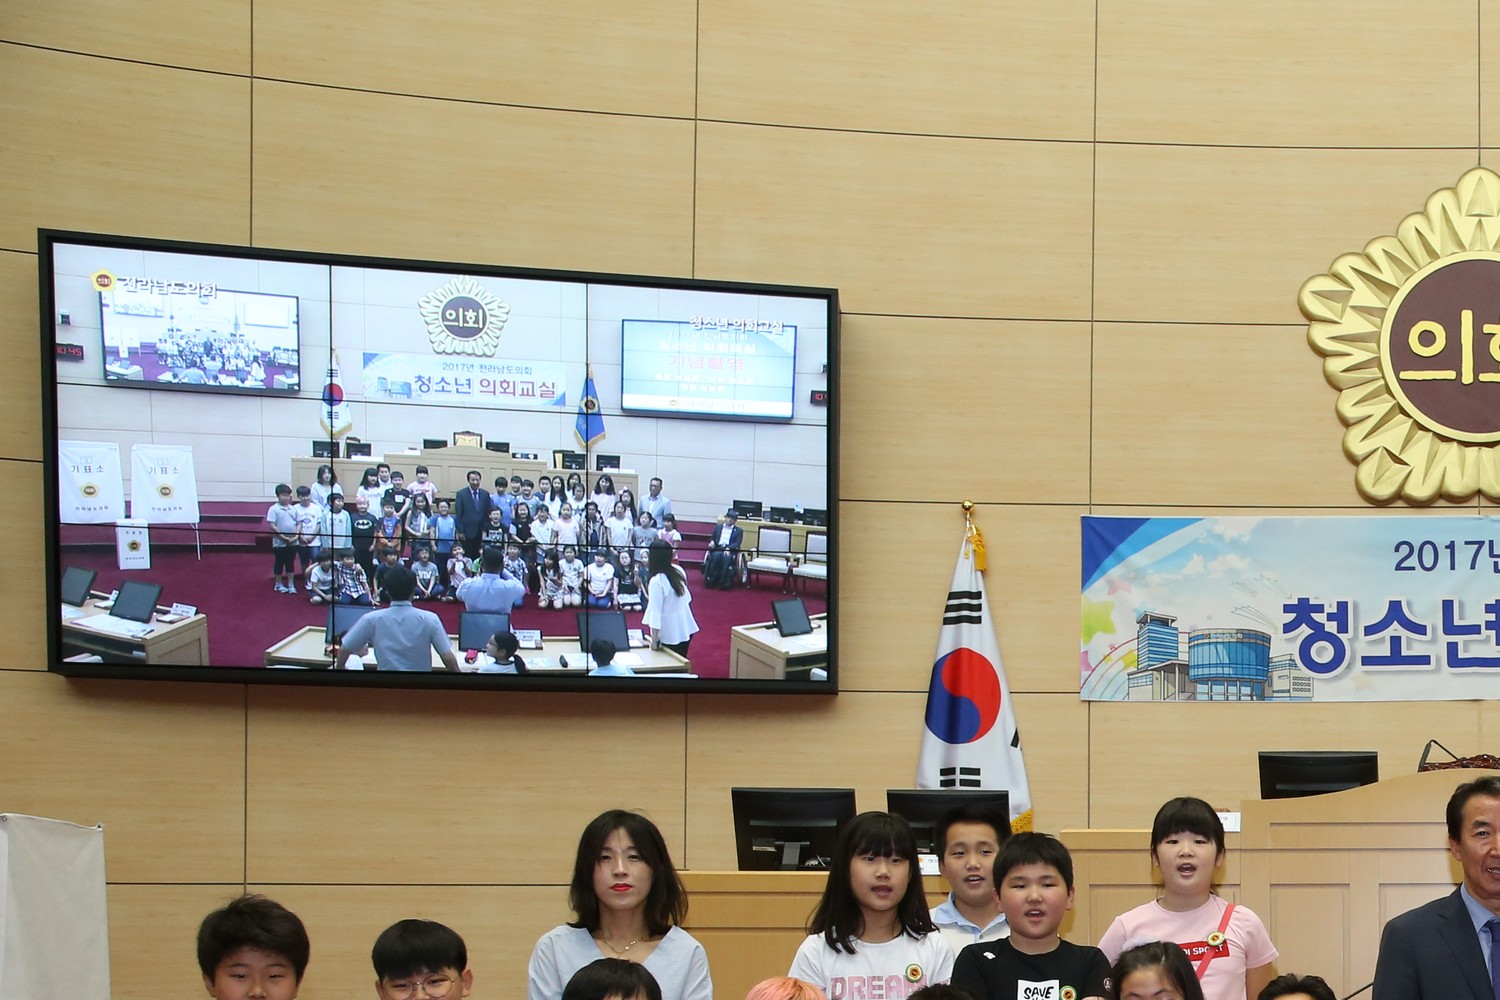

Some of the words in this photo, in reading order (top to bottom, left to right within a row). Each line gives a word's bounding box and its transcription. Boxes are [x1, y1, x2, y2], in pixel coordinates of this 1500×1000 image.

[123, 276, 217, 298] 전라남도의회
[443, 308, 484, 329] 의회
[689, 316, 729, 330] 청소년
[733, 319, 784, 335] 의회교실
[442, 362, 475, 374] 2017년
[479, 363, 533, 376] 전라남도의회
[415, 375, 473, 395] 청소년
[479, 378, 556, 399] 의회교실
[1024, 986, 1054, 999] SAVE
